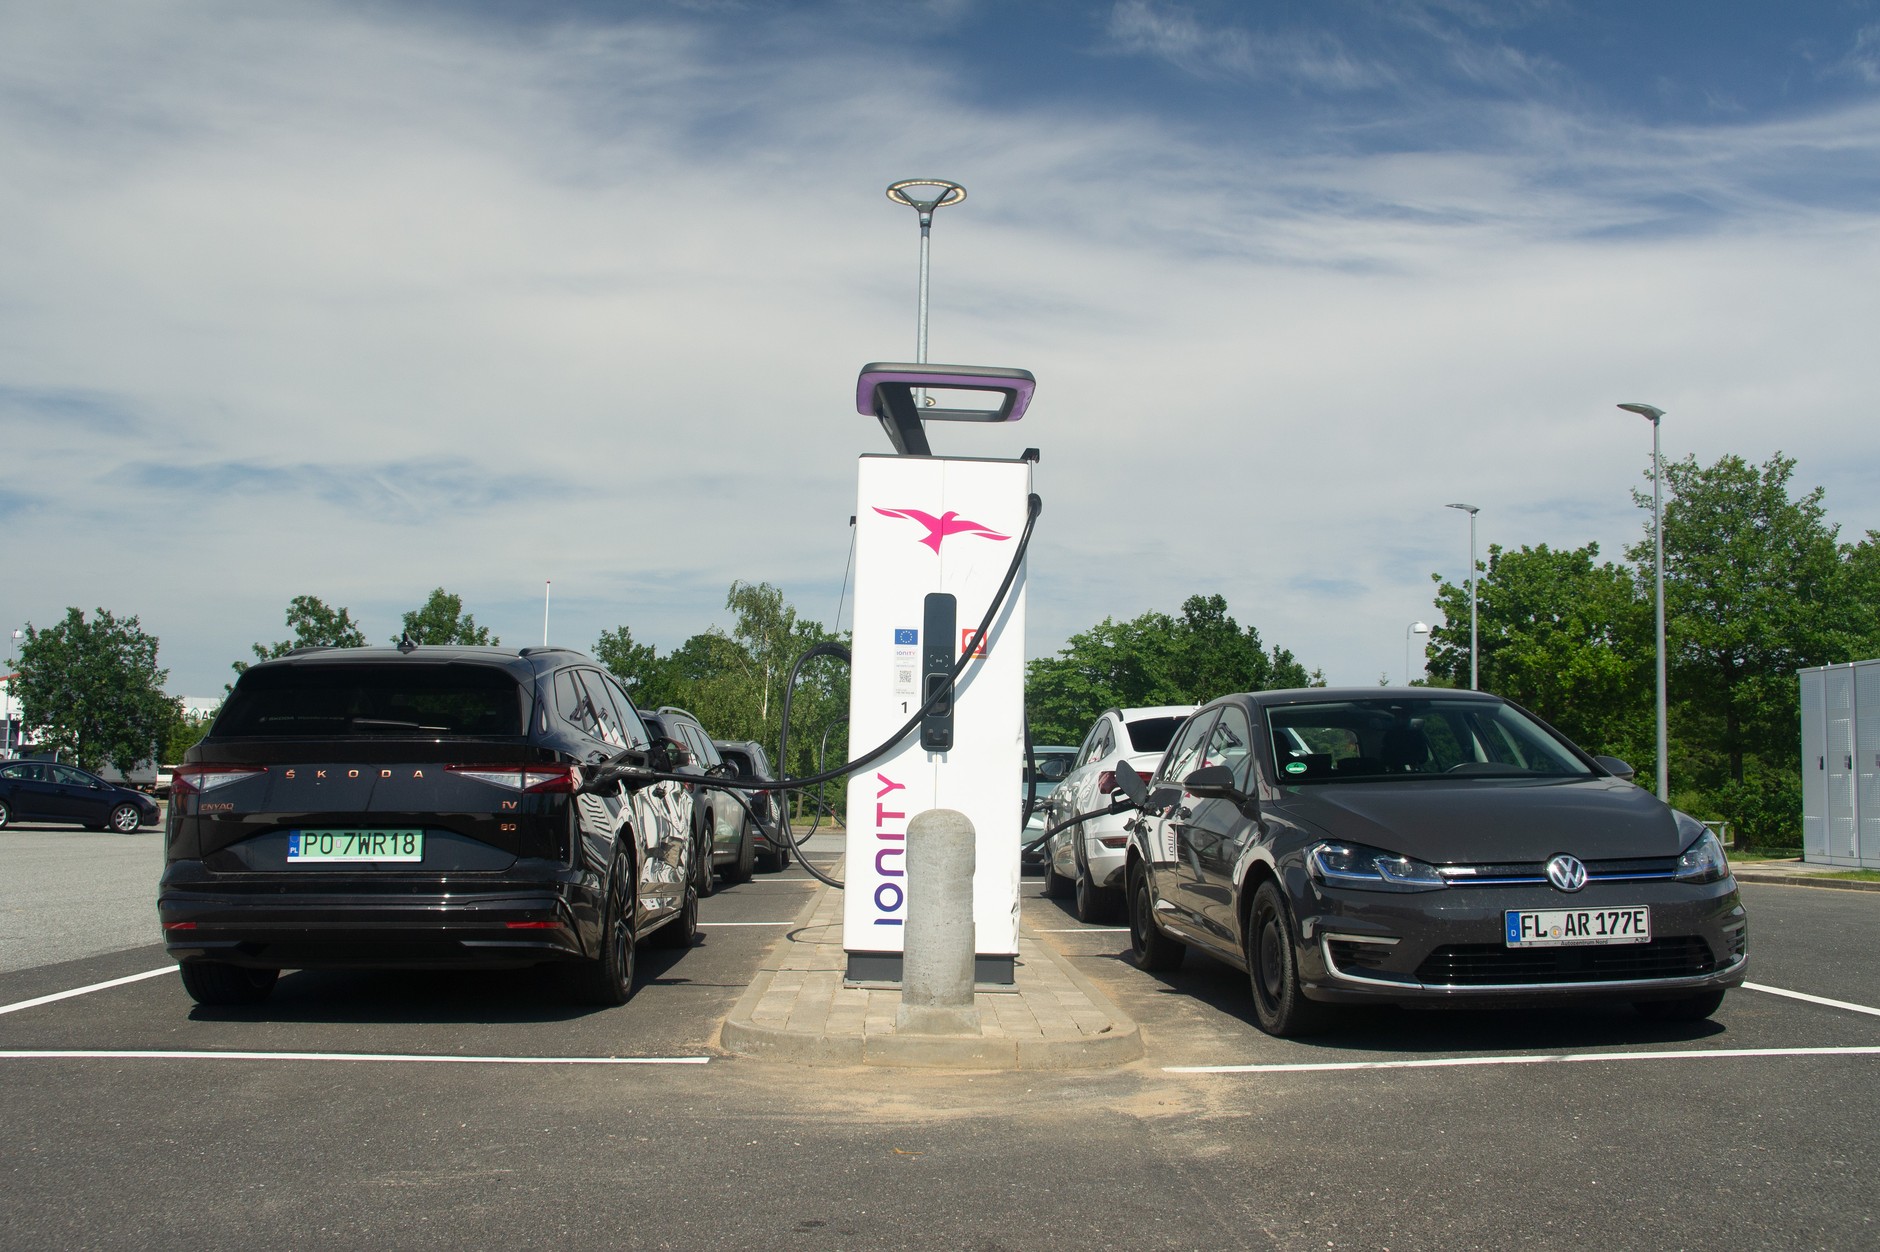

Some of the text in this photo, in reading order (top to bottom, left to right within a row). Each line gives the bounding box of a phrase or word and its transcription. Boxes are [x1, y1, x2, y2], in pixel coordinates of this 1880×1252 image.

[901, 701, 908, 714] 1
[285, 769, 424, 779] ŠKODA
[201, 802, 235, 811] ENYAQ
[500, 823, 517, 831] 80
[343, 832, 415, 855] 7WR18
[873, 772, 906, 926] IONITY
[1521, 911, 1646, 938] FL AR 177E
[1510, 929, 1517, 937] D
